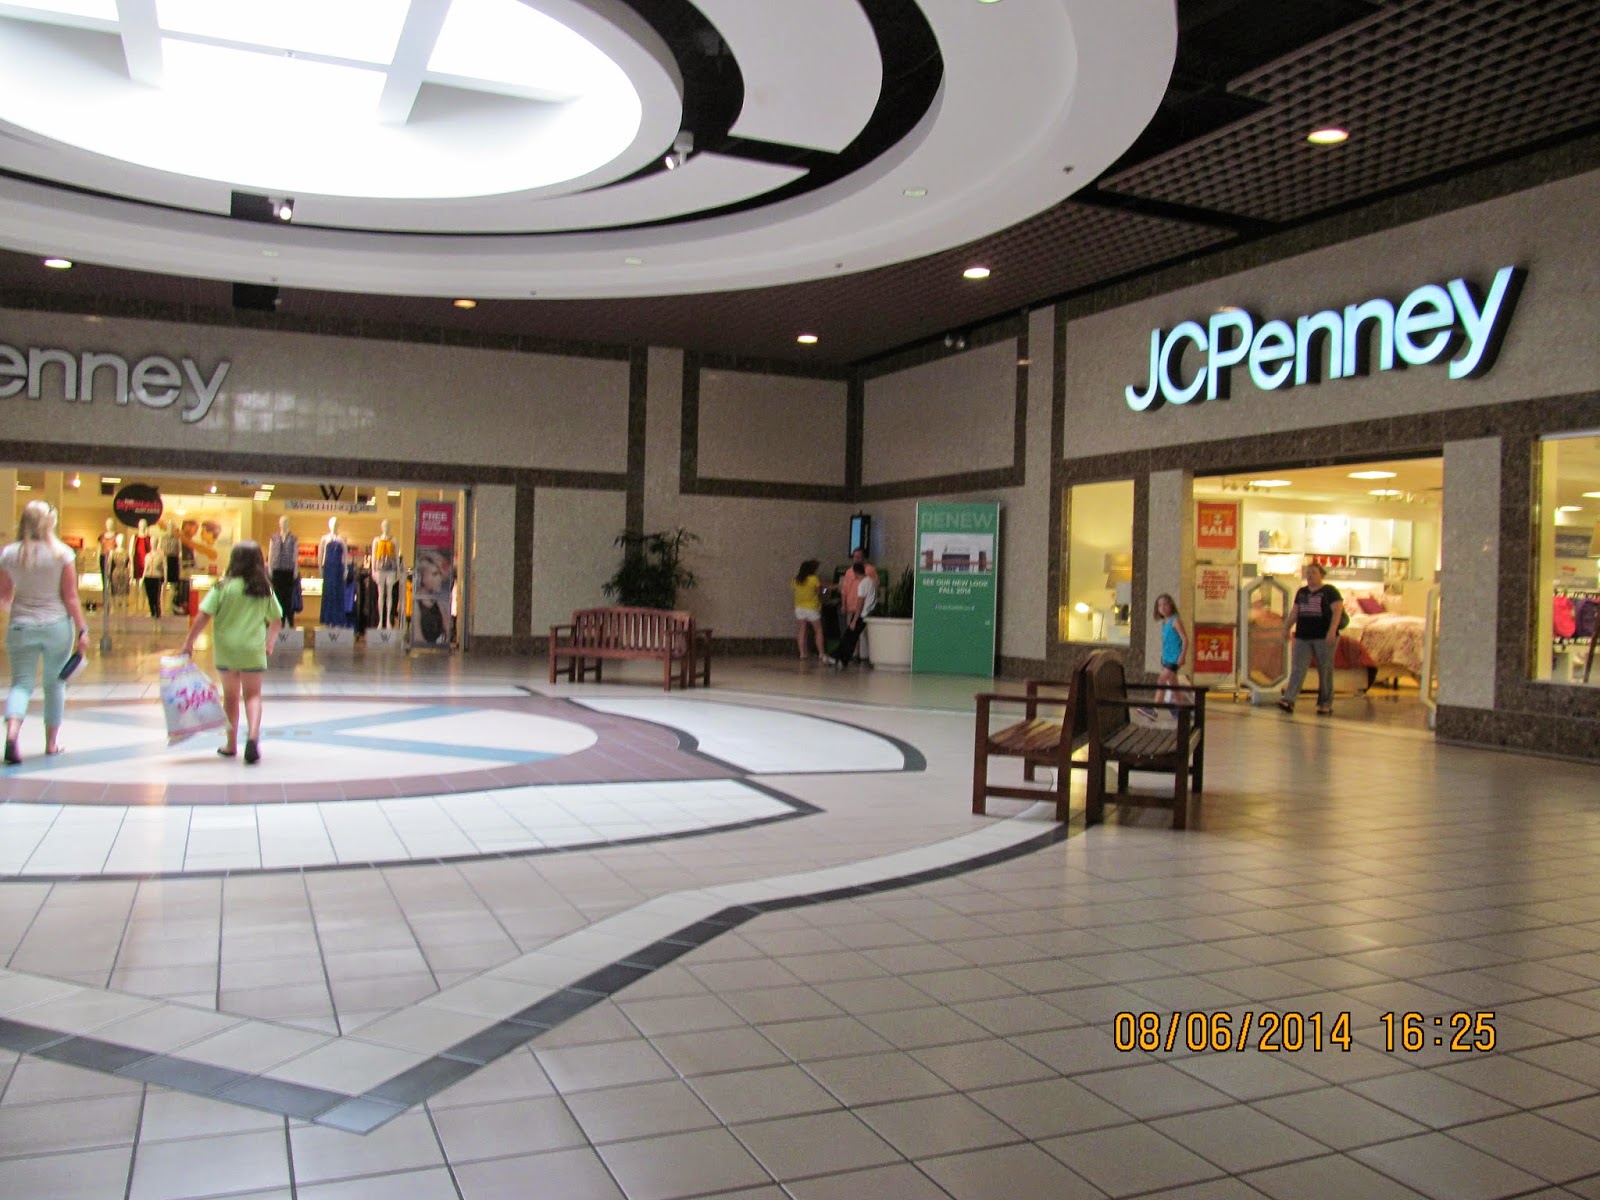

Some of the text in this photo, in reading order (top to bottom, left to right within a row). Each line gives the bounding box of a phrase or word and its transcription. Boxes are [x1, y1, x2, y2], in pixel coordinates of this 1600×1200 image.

[1125, 265, 1518, 412] JCPenney
[319, 482, 345, 501] W
[422, 511, 448, 521] FREE
[921, 510, 993, 530] RENEW
[1200, 524, 1234, 537] SALE
[1196, 649, 1230, 661] SALE
